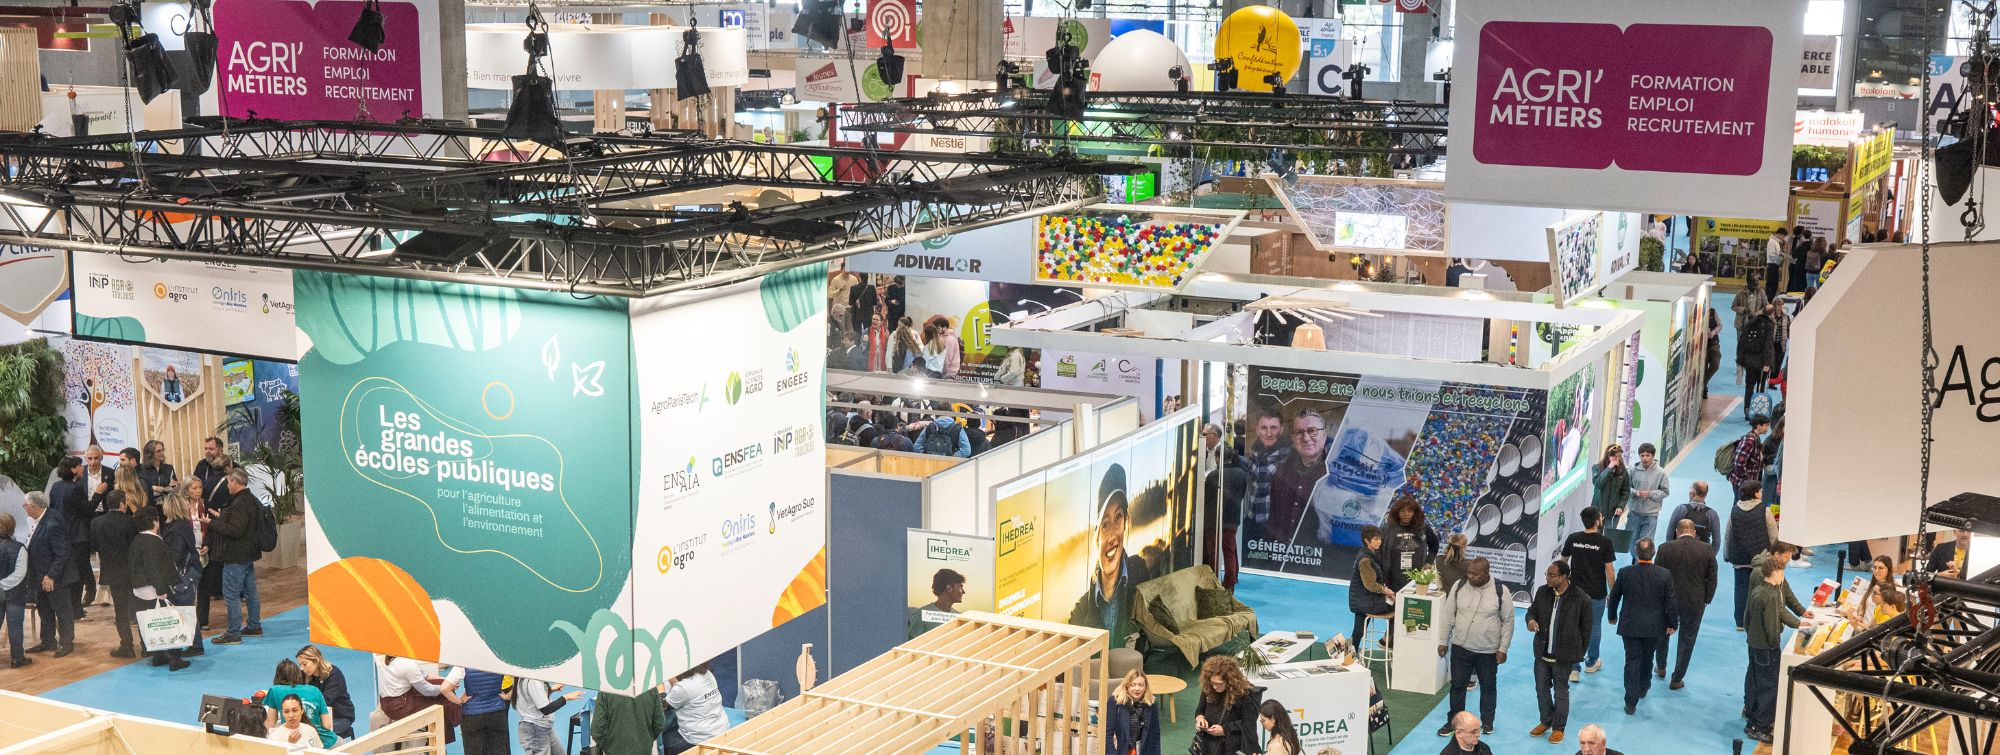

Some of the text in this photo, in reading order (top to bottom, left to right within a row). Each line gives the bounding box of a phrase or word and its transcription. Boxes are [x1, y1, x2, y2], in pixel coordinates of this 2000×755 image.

[228, 40, 303, 74] AGRI'
[1313, 44, 1328, 57] 5.1
[1803, 50, 1832, 60] ERCE
[324, 66, 370, 80] EMPLOI
[473, 70, 491, 81] Bien
[558, 73, 582, 82] vivre
[1317, 64, 1342, 94] C
[1801, 64, 1831, 74] ABLE
[227, 70, 308, 96] MÉTIERS
[325, 85, 415, 102] RECRUTEMENT
[1492, 67, 1604, 104] AGRI'
[1630, 74, 1735, 92] FORMATION
[1489, 98, 1603, 129] MÉTIERS
[1629, 95, 1694, 113] EMPLOI
[1627, 117, 1755, 136] RECRUTEMENT
[89, 276, 109, 289] INP
[168, 292, 188, 303] agro
[212, 286, 247, 303] Oniris
[744, 381, 764, 396] AGRO
[776, 371, 808, 392] ENGEES
[1934, 344, 2000, 423] Ag
[651, 391, 699, 415] AgroParisTech
[1261, 374, 1530, 413] Depuis 25 ans, nous trions et recyclons
[379, 404, 421, 431] Les
[380, 427, 473, 458] grandes
[773, 432, 793, 455] INP
[724, 442, 763, 468] ENSFEA
[355, 443, 555, 492] écoles publiques
[437, 486, 522, 508] pour l'agriculture
[462, 504, 543, 525] l'alimentation et
[776, 502, 802, 521] VetAgro
[802, 496, 815, 510] Sup
[463, 516, 544, 538] l'environnement
[721, 513, 756, 539] Oniris
[1002, 521, 1034, 545] IHEDREA
[673, 550, 695, 570] agro
[930, 545, 970, 557] IHEDREA
[1293, 718, 1349, 736] DREA
